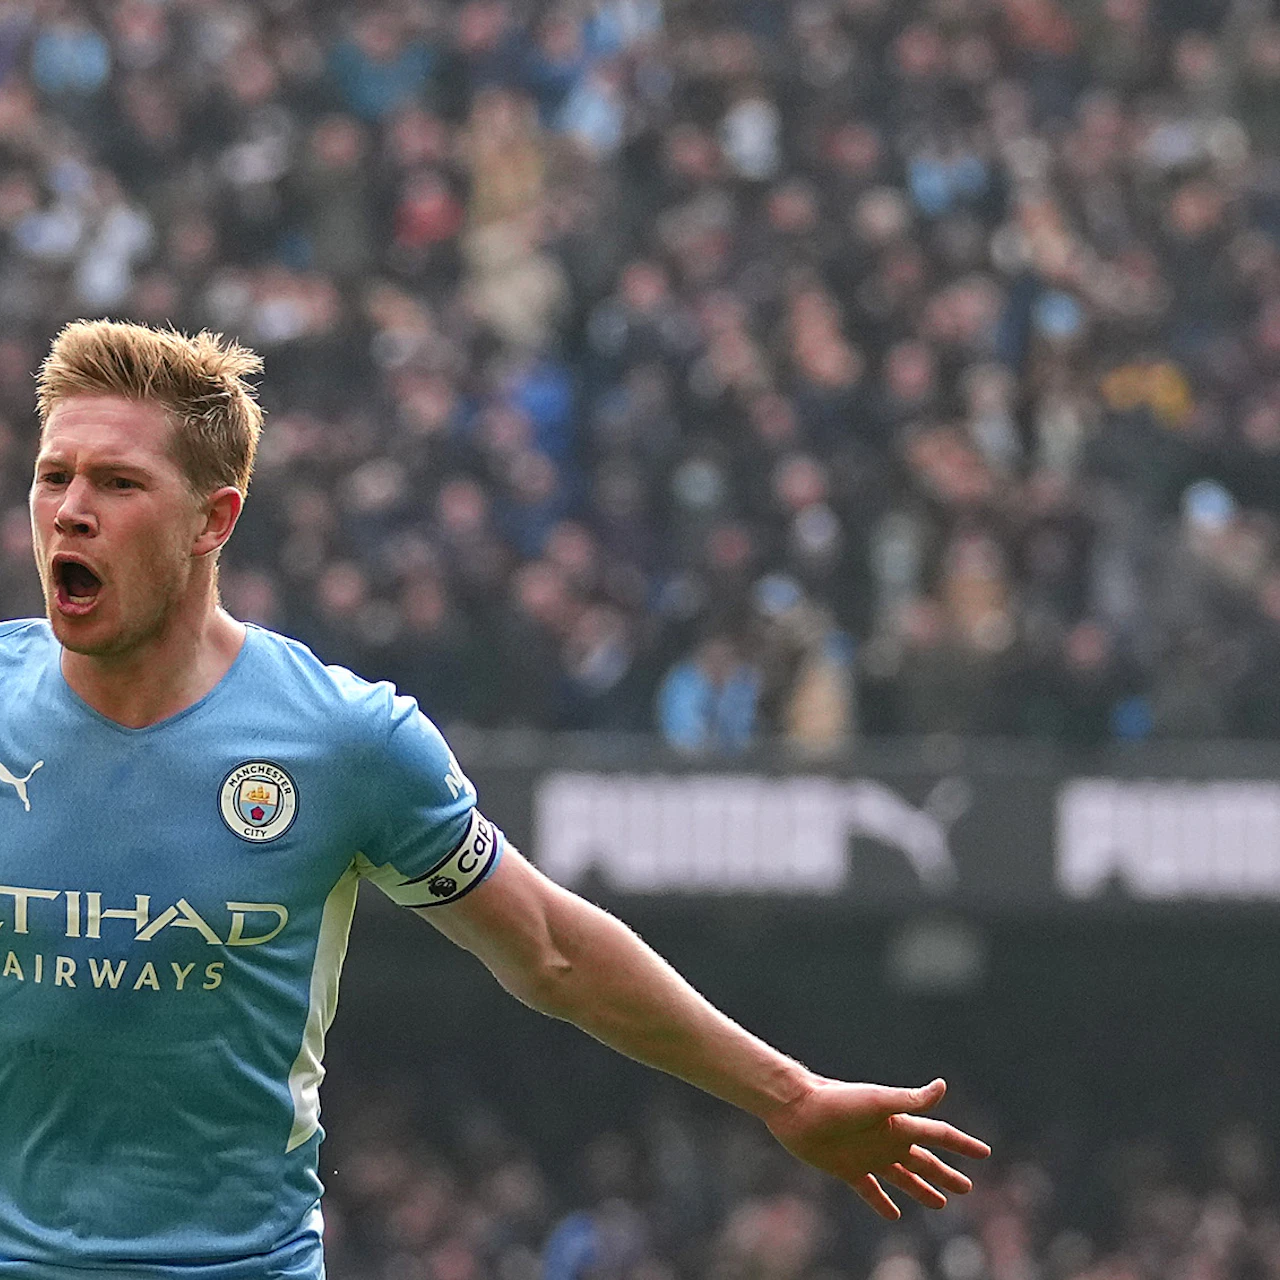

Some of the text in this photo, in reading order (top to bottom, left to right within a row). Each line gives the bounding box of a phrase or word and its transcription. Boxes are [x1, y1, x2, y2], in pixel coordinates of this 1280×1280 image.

[228, 765, 292, 795] MANCHESTER
[243, 828, 268, 838] CITY
[457, 819, 492, 874] Cap
[2, 951, 225, 991] AIRWAYS
